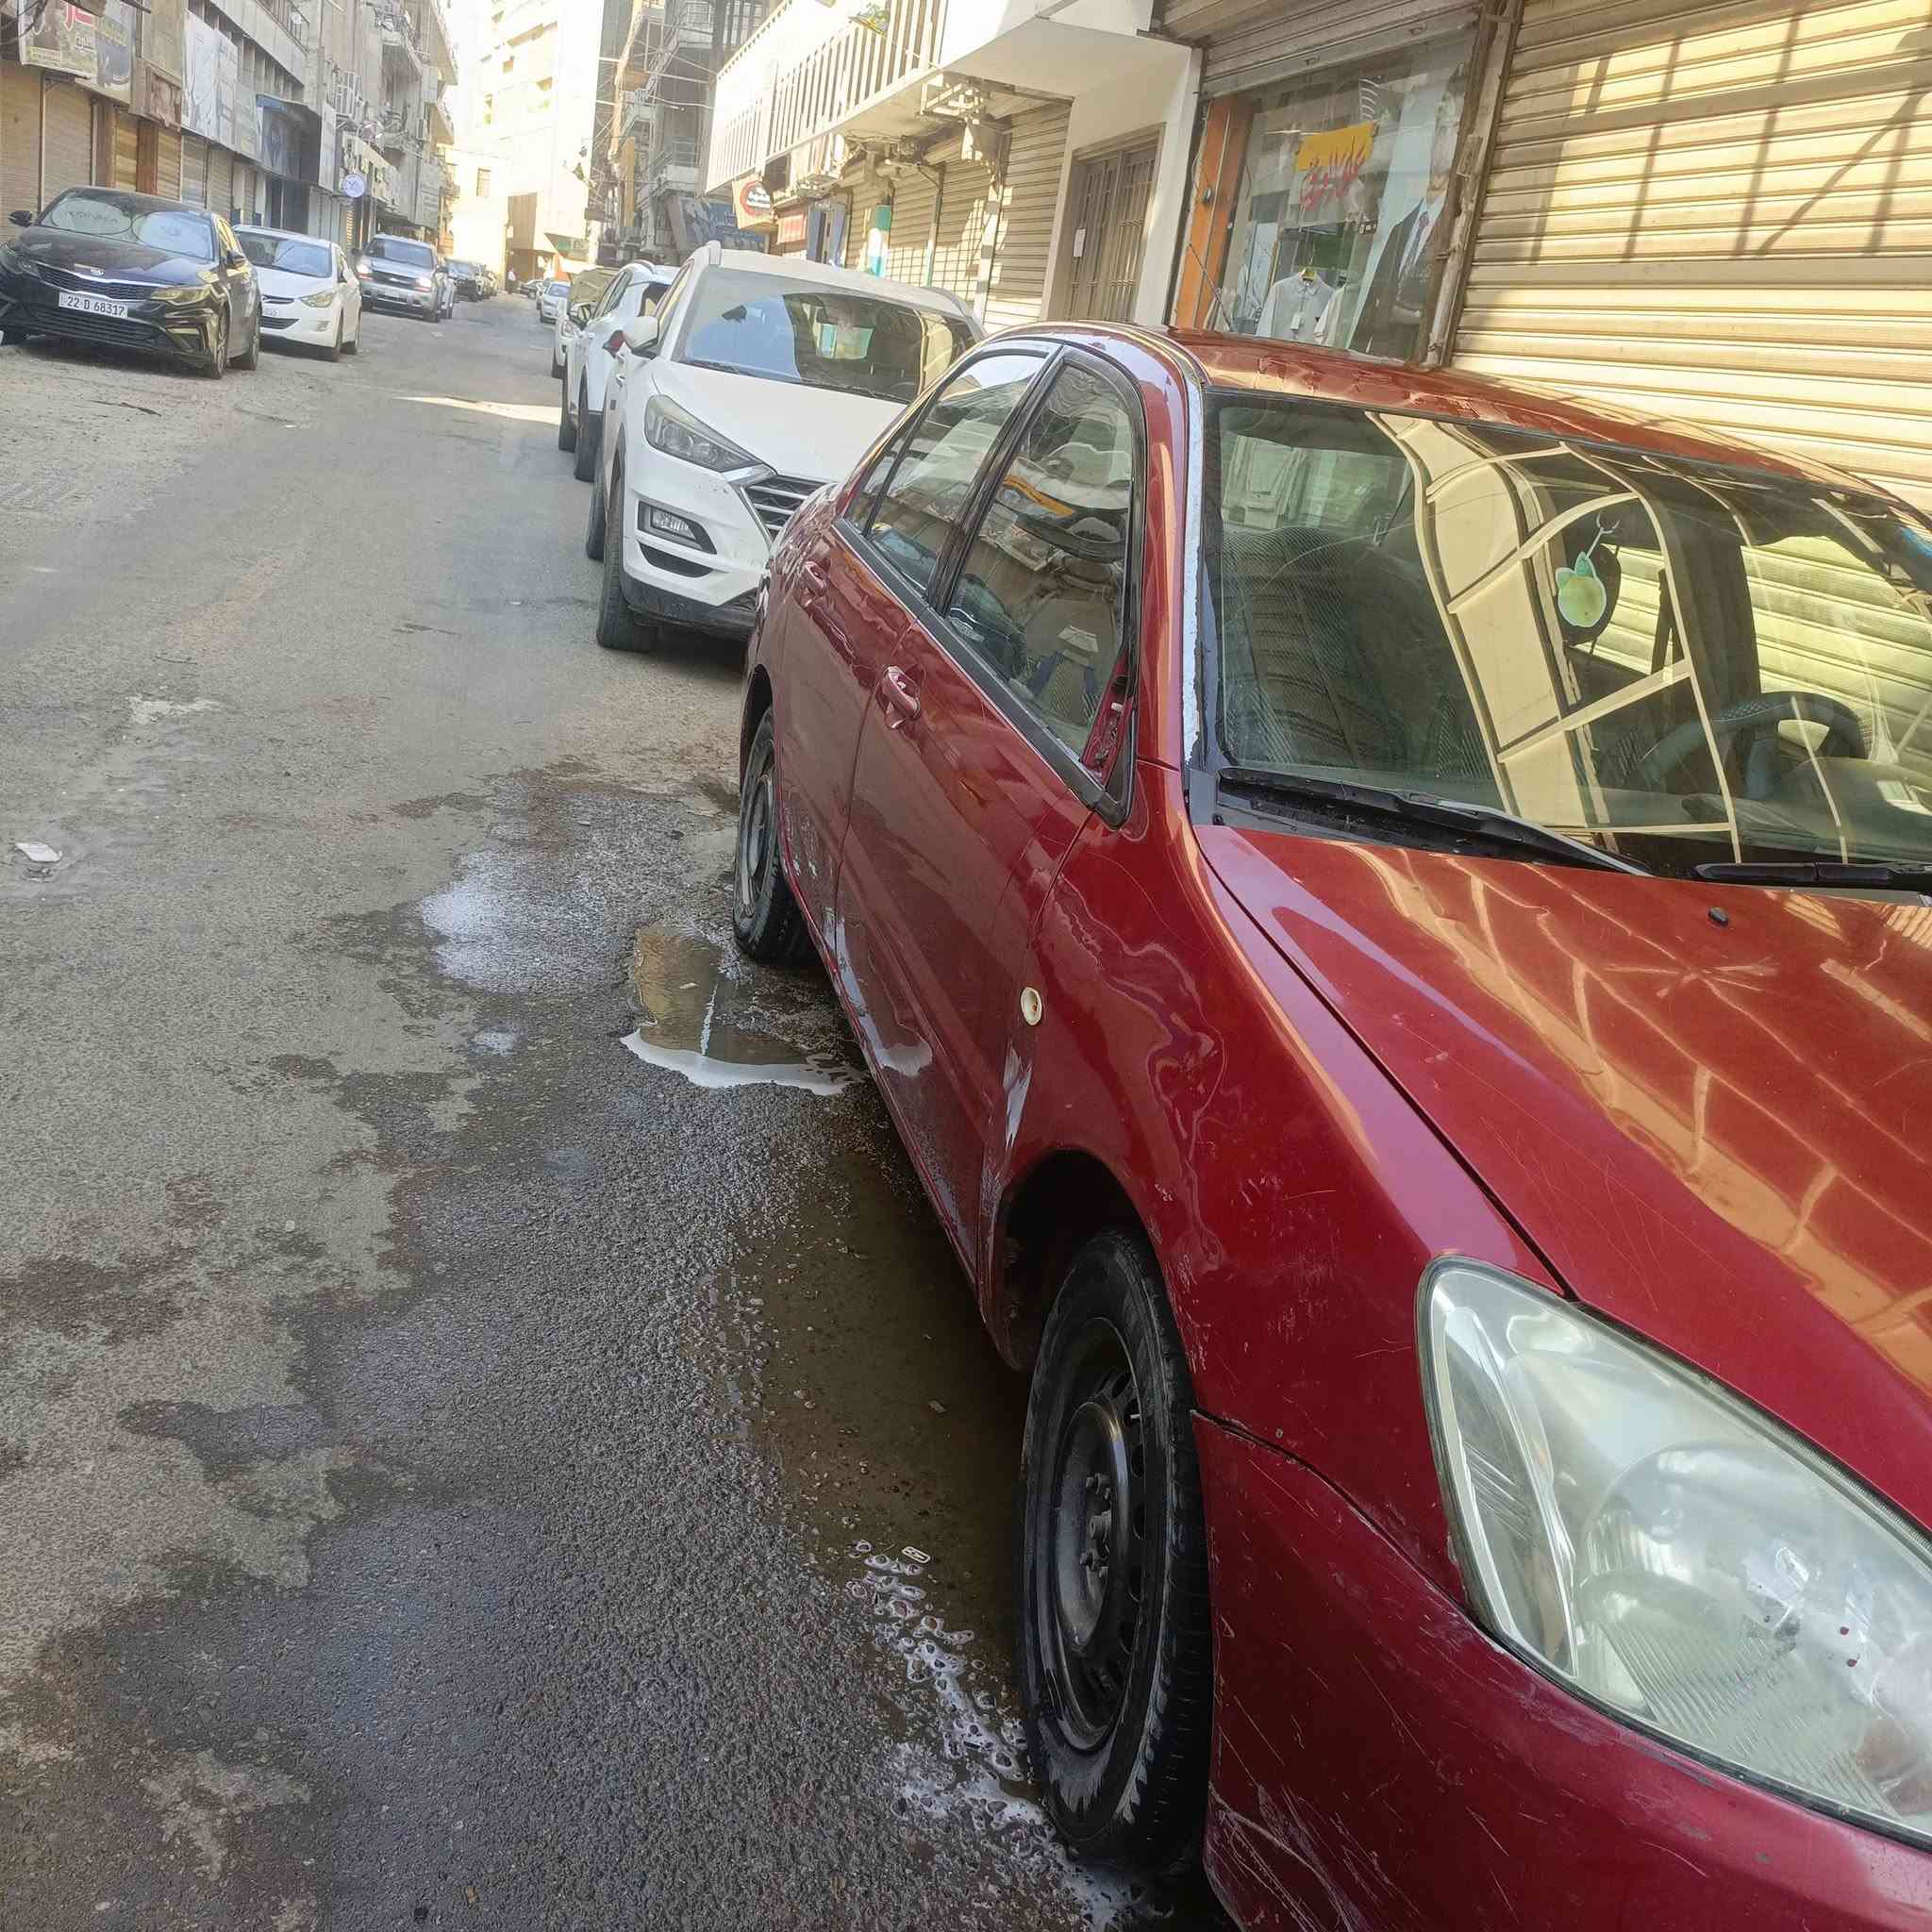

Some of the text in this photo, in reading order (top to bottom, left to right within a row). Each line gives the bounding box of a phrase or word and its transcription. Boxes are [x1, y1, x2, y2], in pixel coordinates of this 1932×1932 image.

[67, 295, 79, 308] 22
[84, 299, 91, 309] D
[93, 301, 125, 316] 68317
